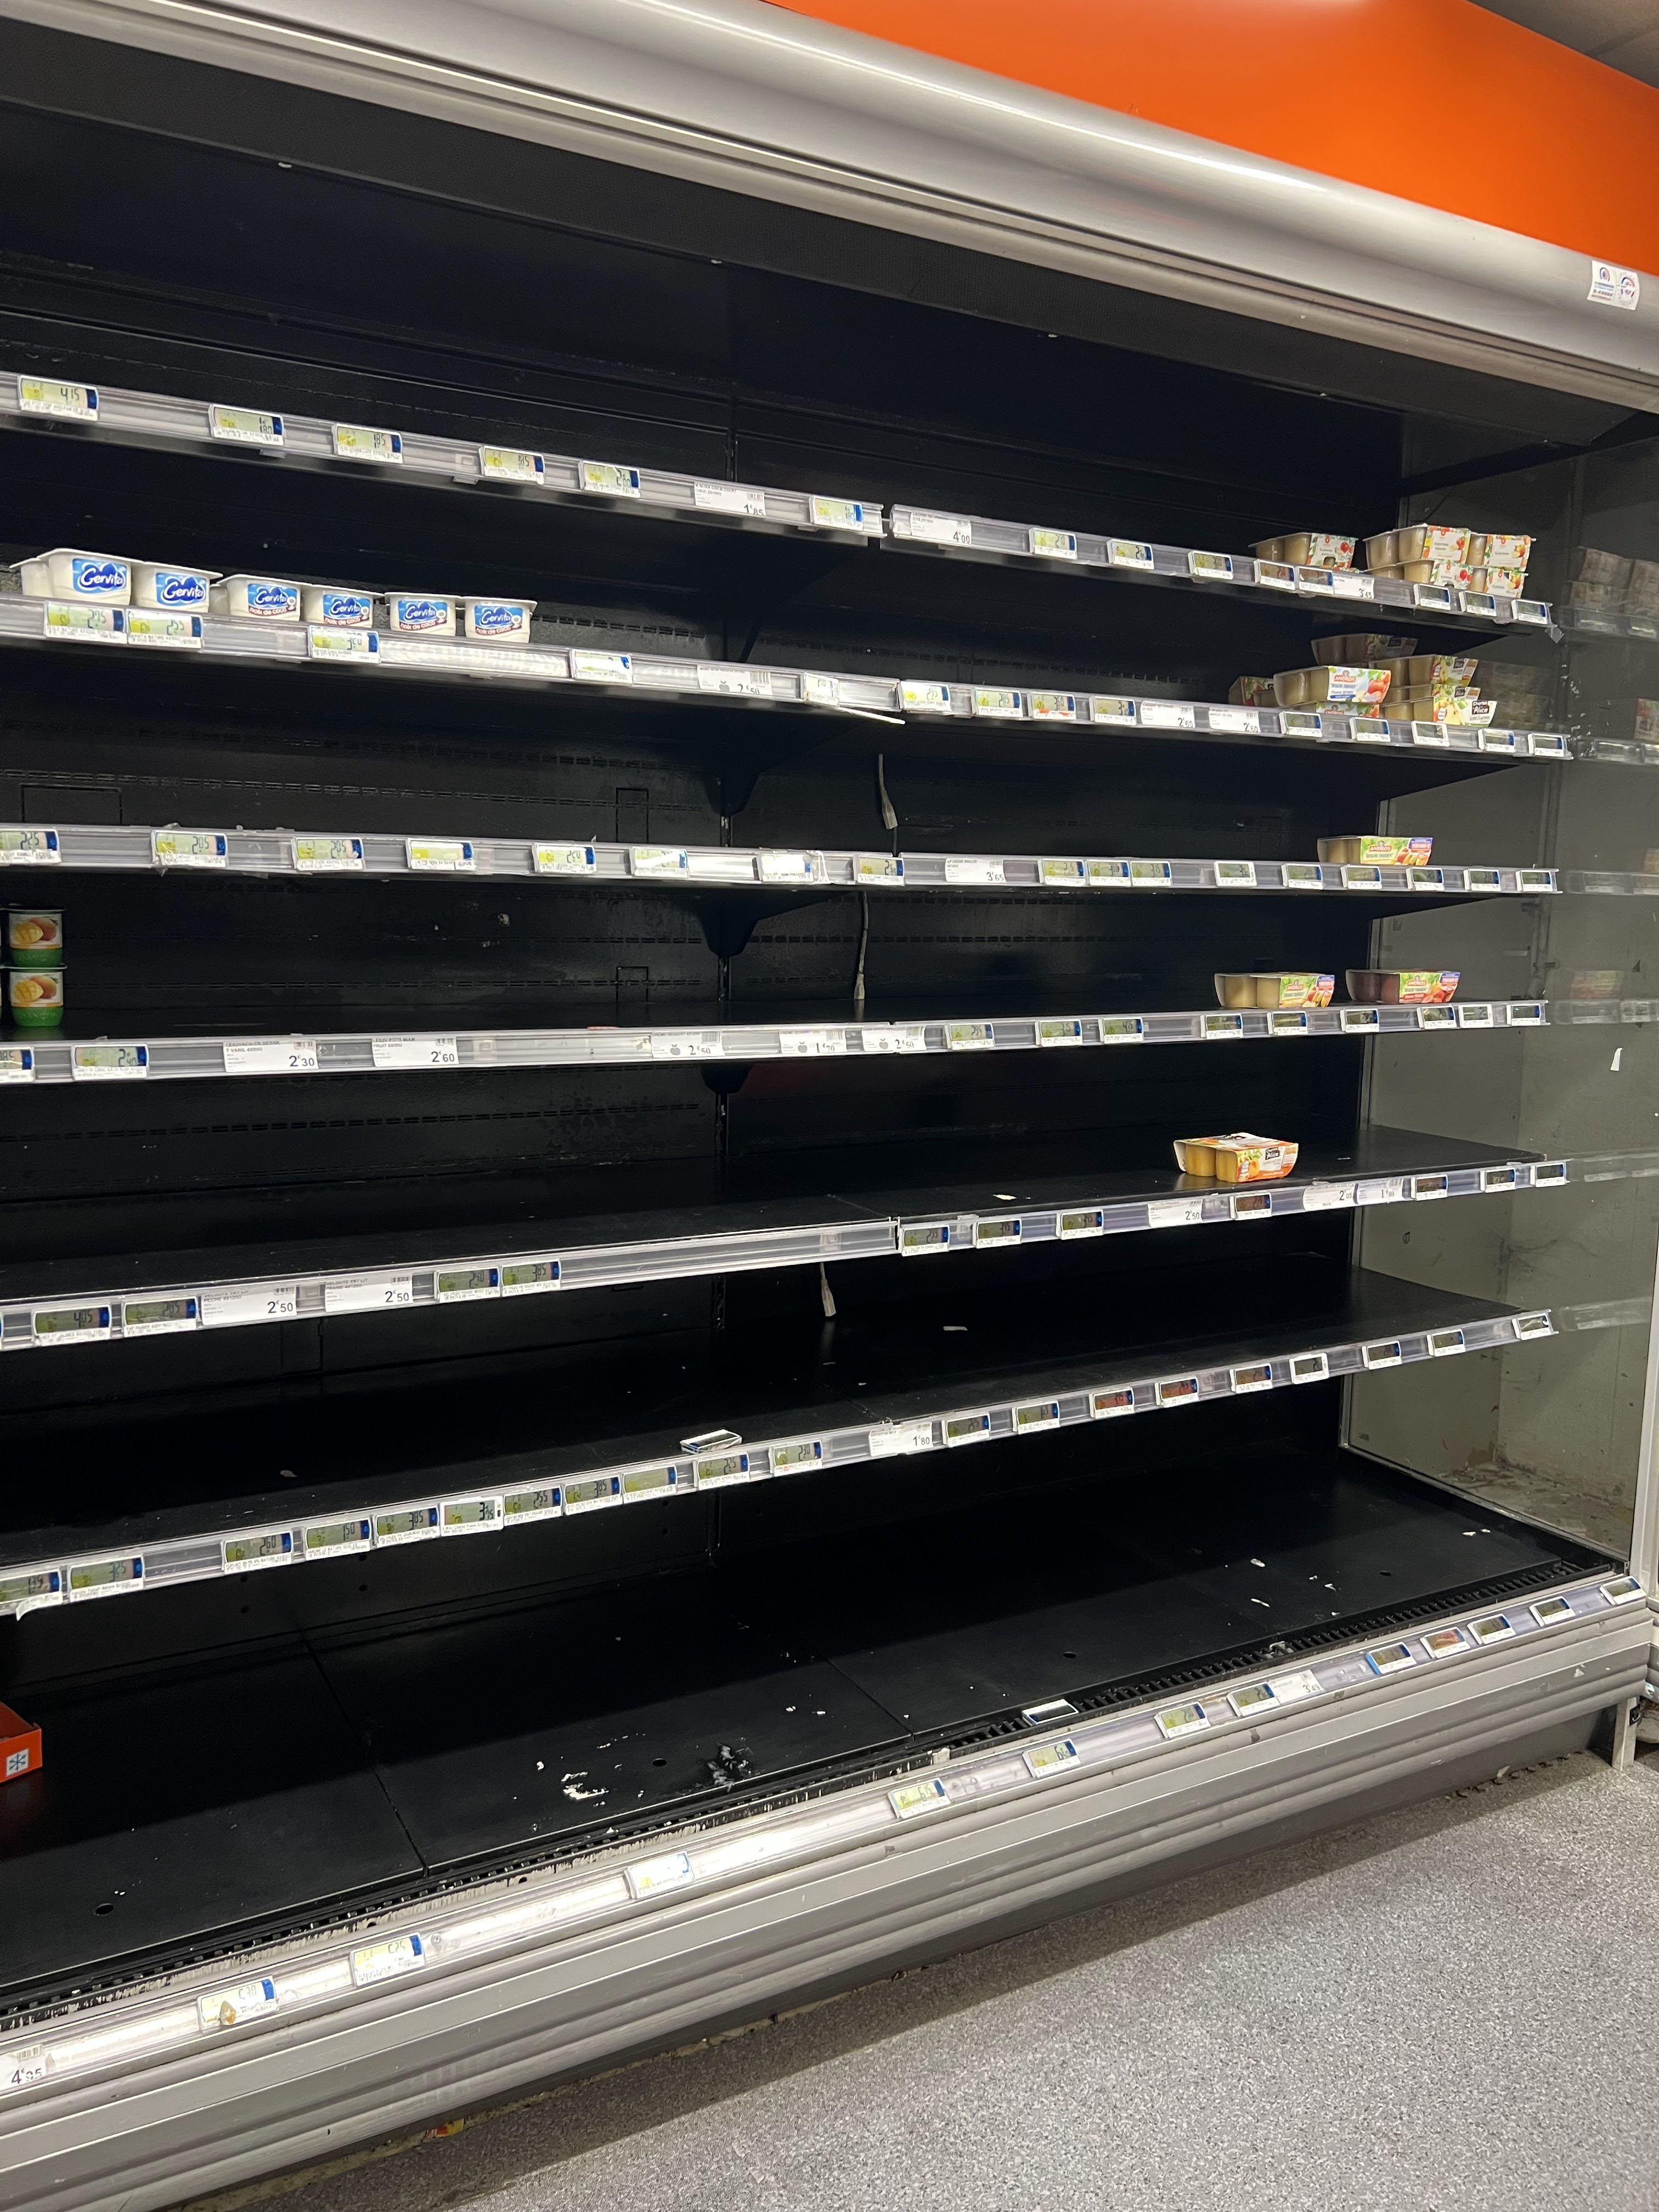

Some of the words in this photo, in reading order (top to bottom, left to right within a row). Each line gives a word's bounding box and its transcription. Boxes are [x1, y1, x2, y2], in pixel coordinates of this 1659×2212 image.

[81, 568, 124, 586] Gervita
[163, 583, 204, 601] Gervita
[256, 591, 287, 603] Gervita
[250, 607, 262, 615] noix
[331, 601, 360, 614] Gervita
[406, 606, 436, 619] Gervita
[324, 617, 337, 625] noix
[481, 612, 511, 624] Gervita
